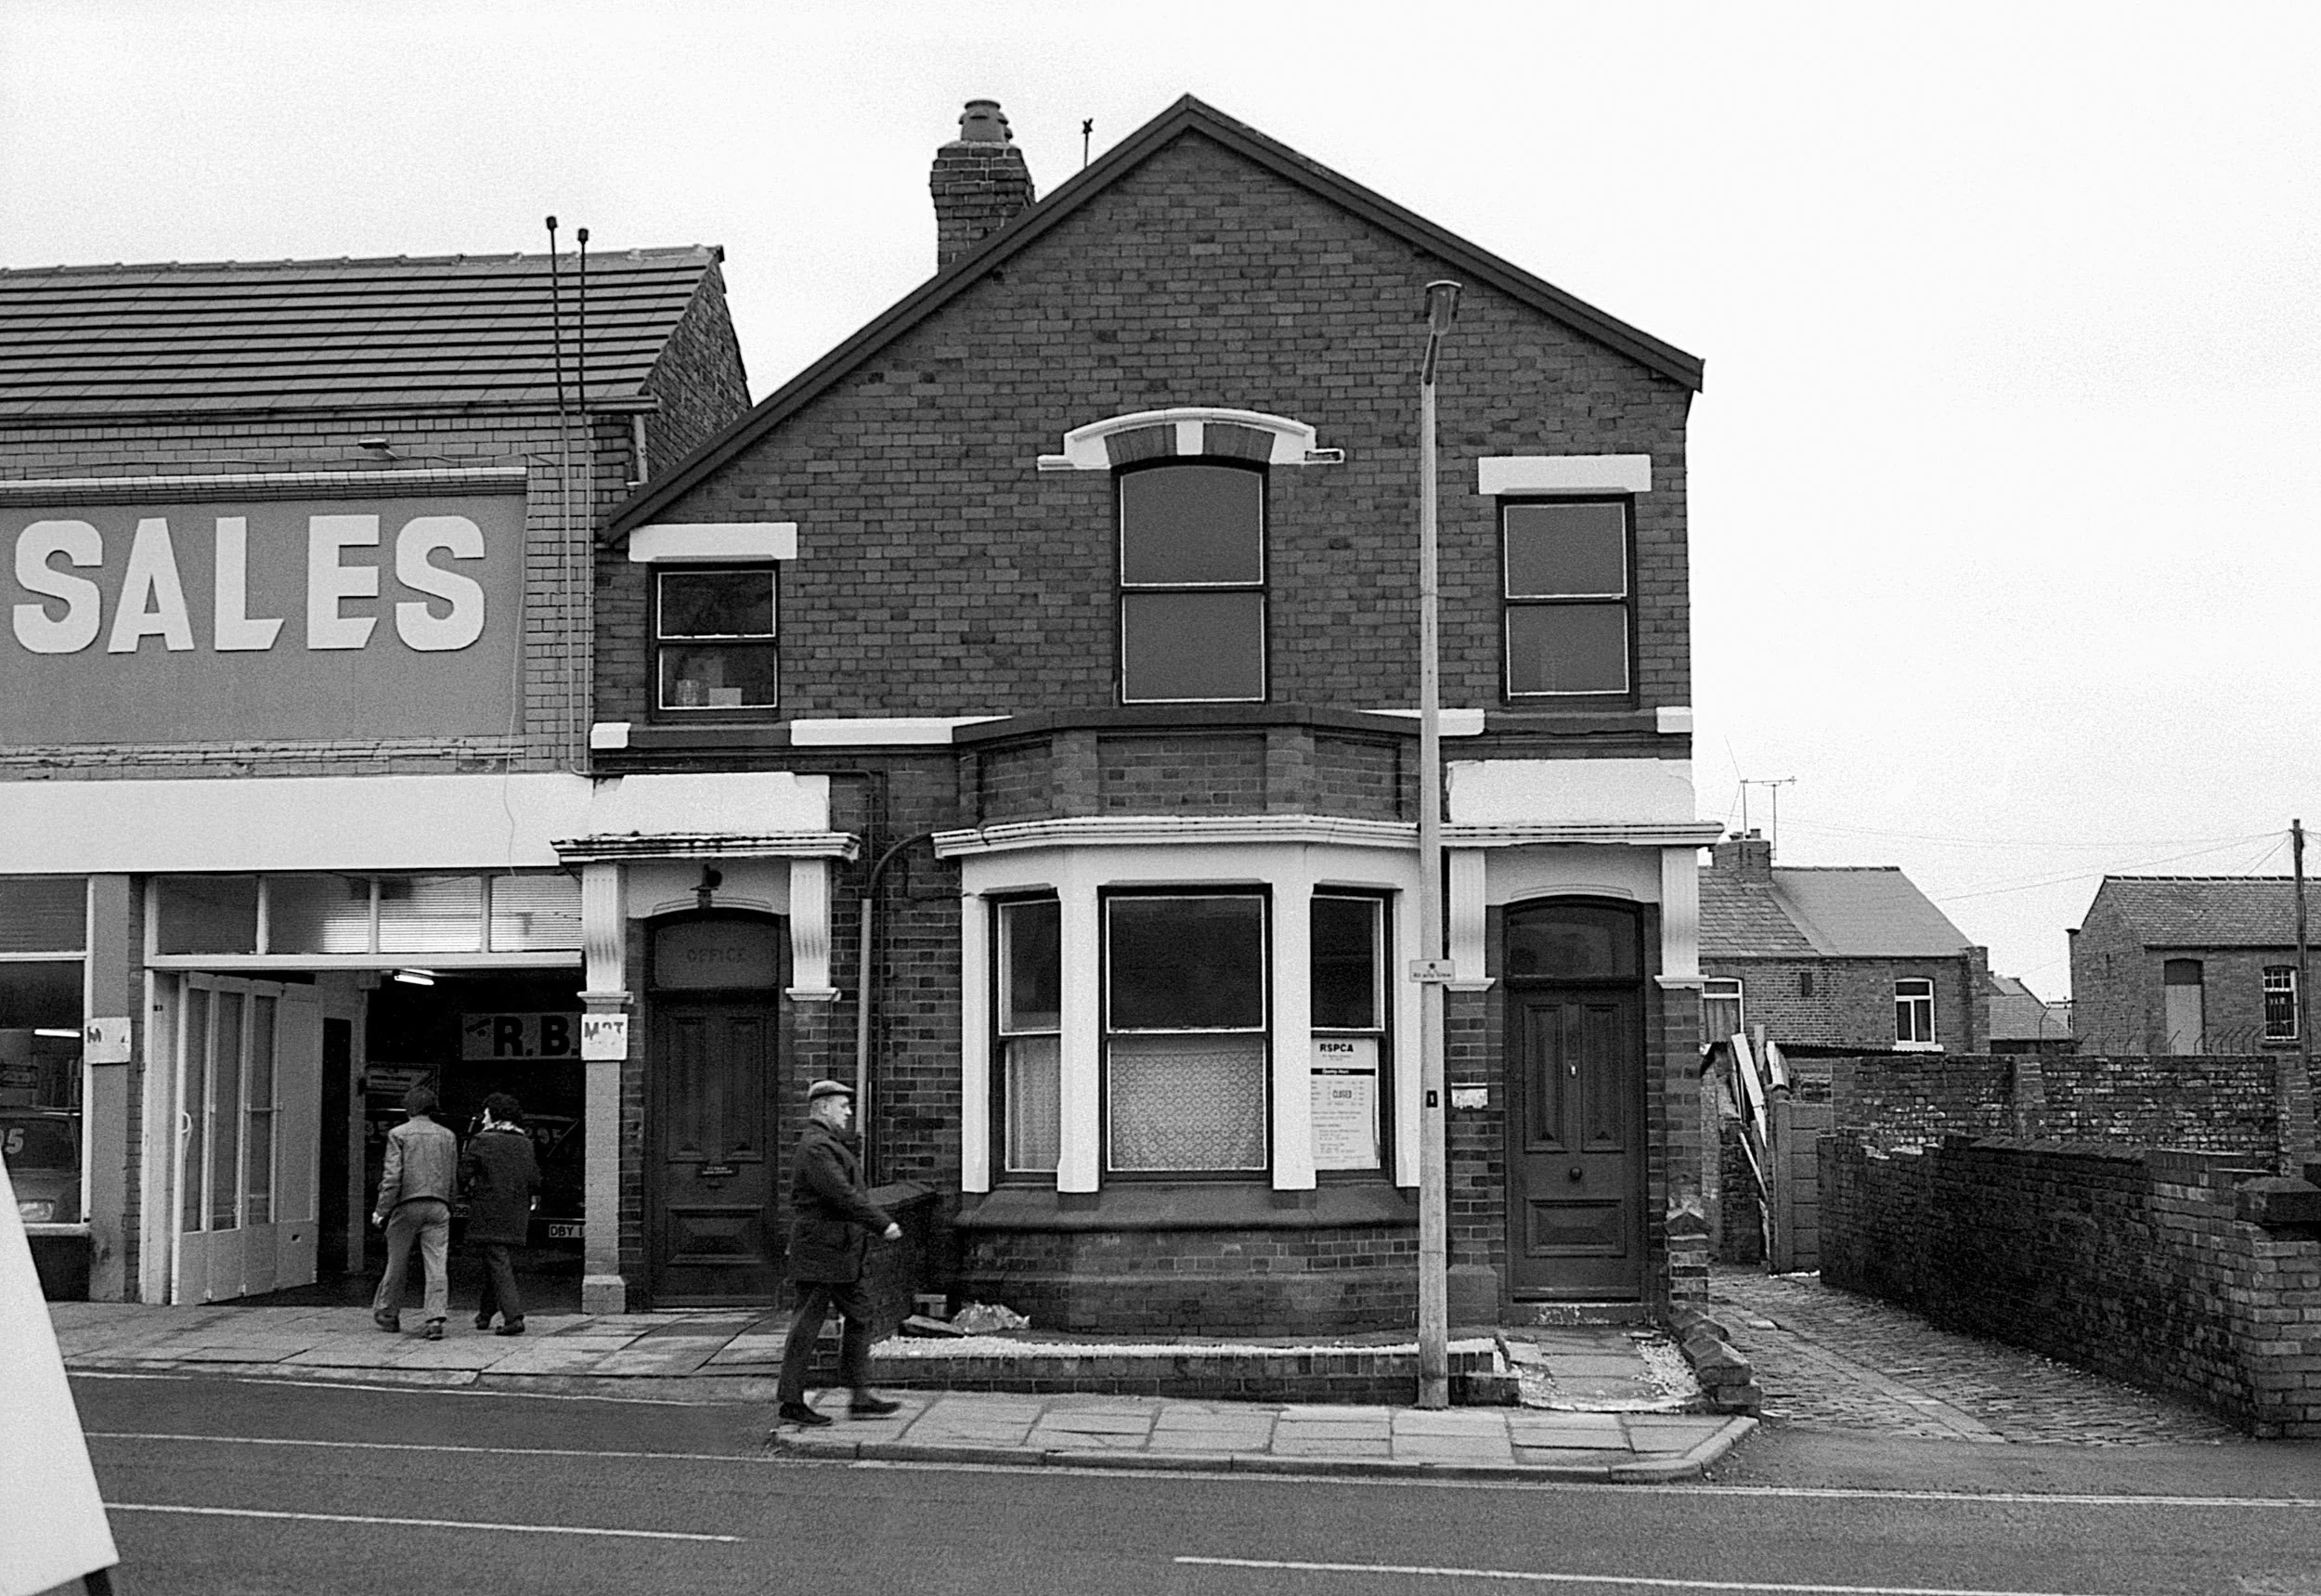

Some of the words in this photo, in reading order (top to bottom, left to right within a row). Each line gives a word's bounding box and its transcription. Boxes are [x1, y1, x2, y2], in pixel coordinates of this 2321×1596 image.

[12, 514, 486, 655] SALES
[686, 948, 746, 964] OFFICE
[1319, 1043, 1354, 1053] RSPCA
[551, 1226, 574, 1237] DBY
